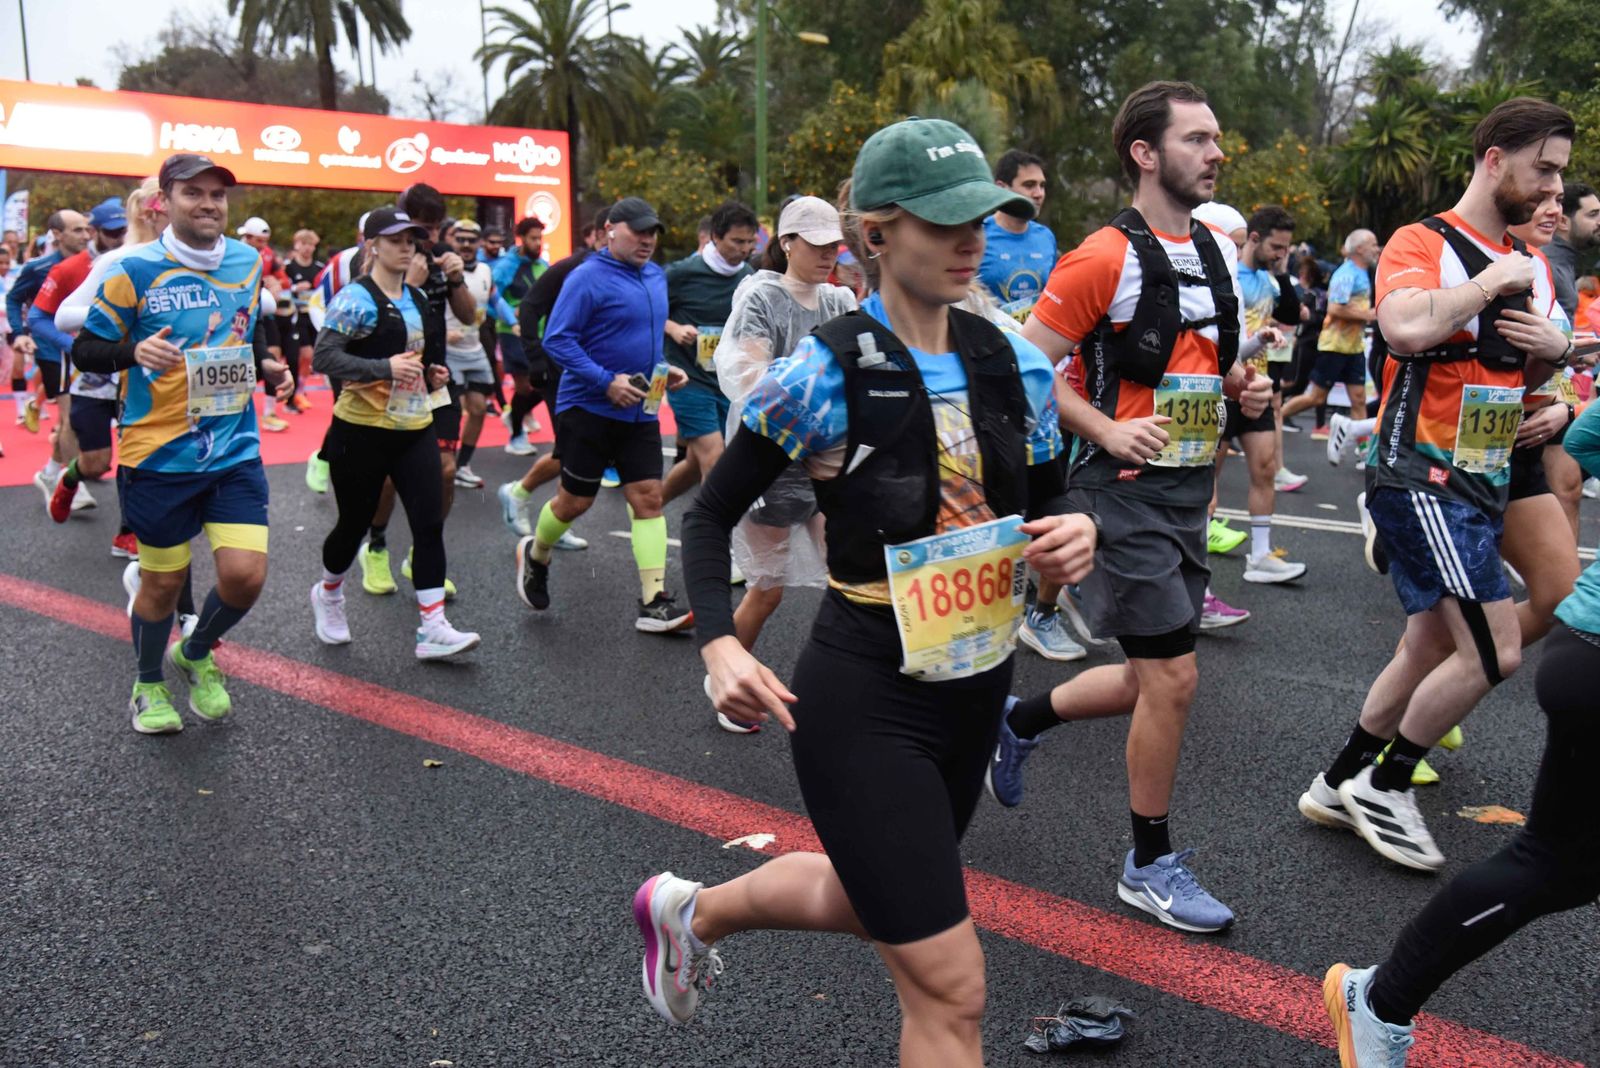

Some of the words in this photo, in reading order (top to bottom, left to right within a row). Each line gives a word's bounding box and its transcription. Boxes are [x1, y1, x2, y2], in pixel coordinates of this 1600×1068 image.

[160, 122, 242, 155] HOKA
[145, 287, 169, 297] MEDIO
[147, 288, 220, 314] SEVILLA
[195, 363, 247, 386] 19562
[1163, 398, 1219, 425] 13135
[1386, 401, 1408, 468] ALZHEIMER'S
[907, 557, 1012, 621] 18868
[1347, 980, 1357, 1012] HOKA
